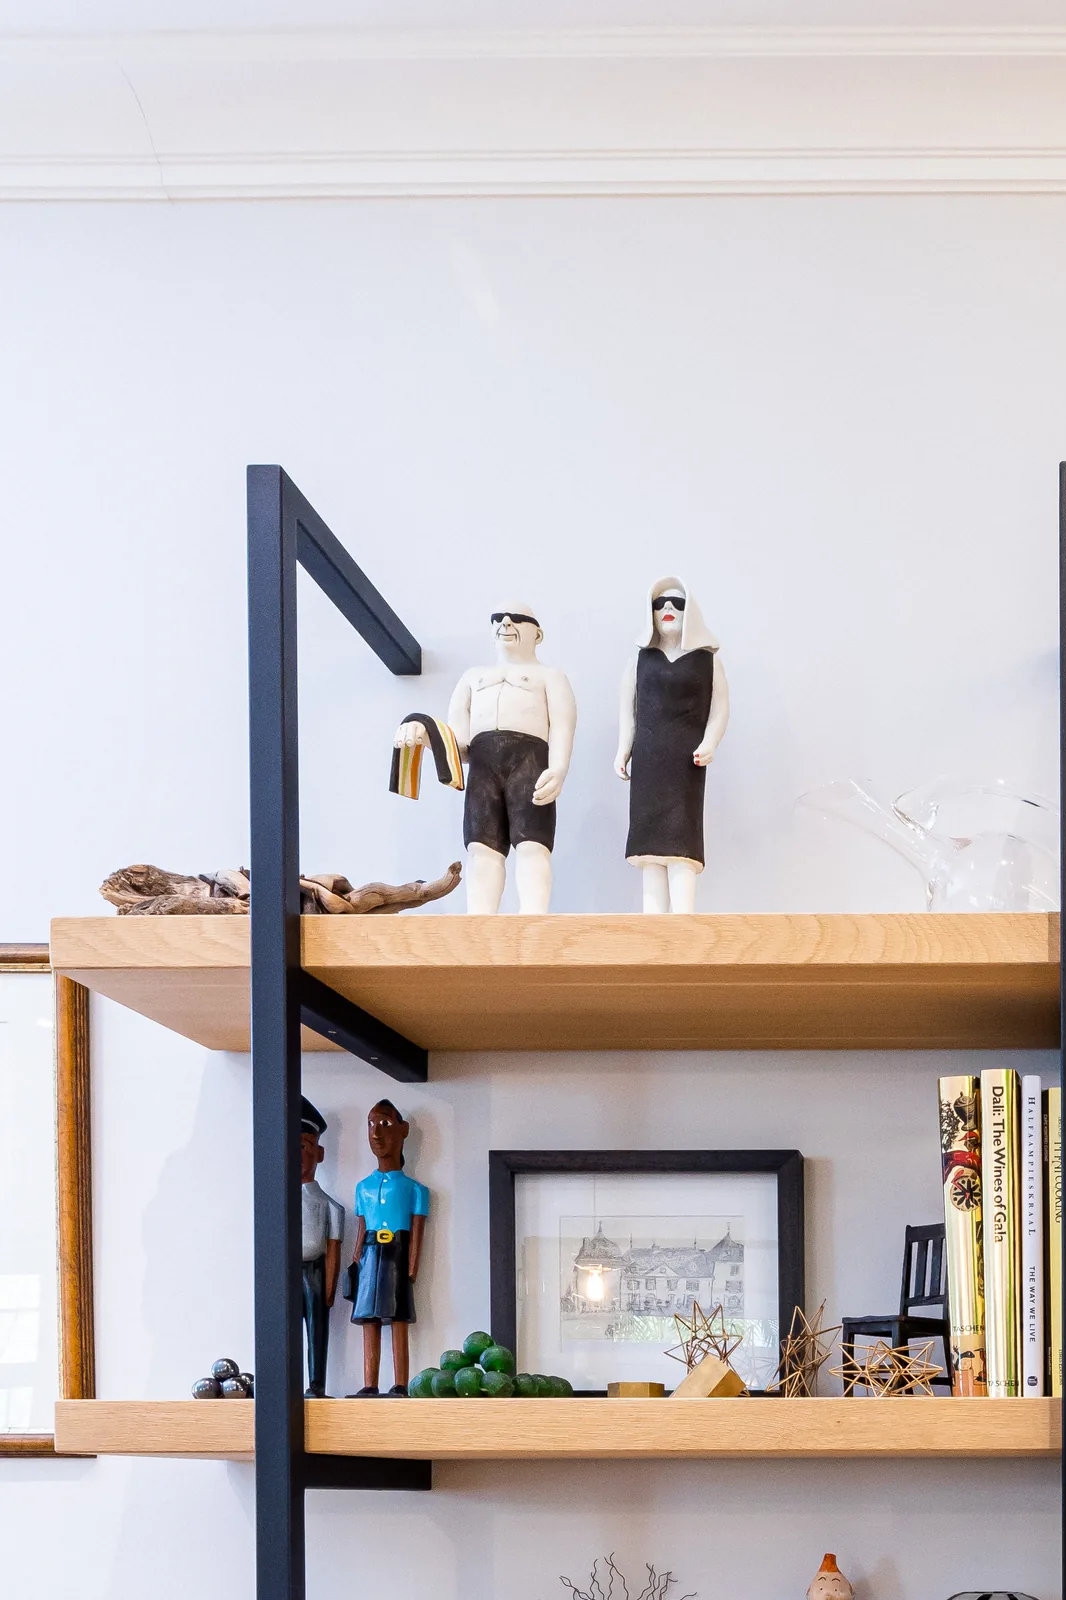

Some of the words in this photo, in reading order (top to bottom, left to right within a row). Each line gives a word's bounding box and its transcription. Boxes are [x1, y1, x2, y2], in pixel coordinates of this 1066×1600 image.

[992, 1086, 1005, 1116] Dali:
[992, 1119, 1005, 1146] The
[993, 1147, 1006, 1192] Wines
[993, 1195, 1007, 1209] of
[994, 1212, 1007, 1243] Gala
[1029, 1307, 1036, 1320] WE
